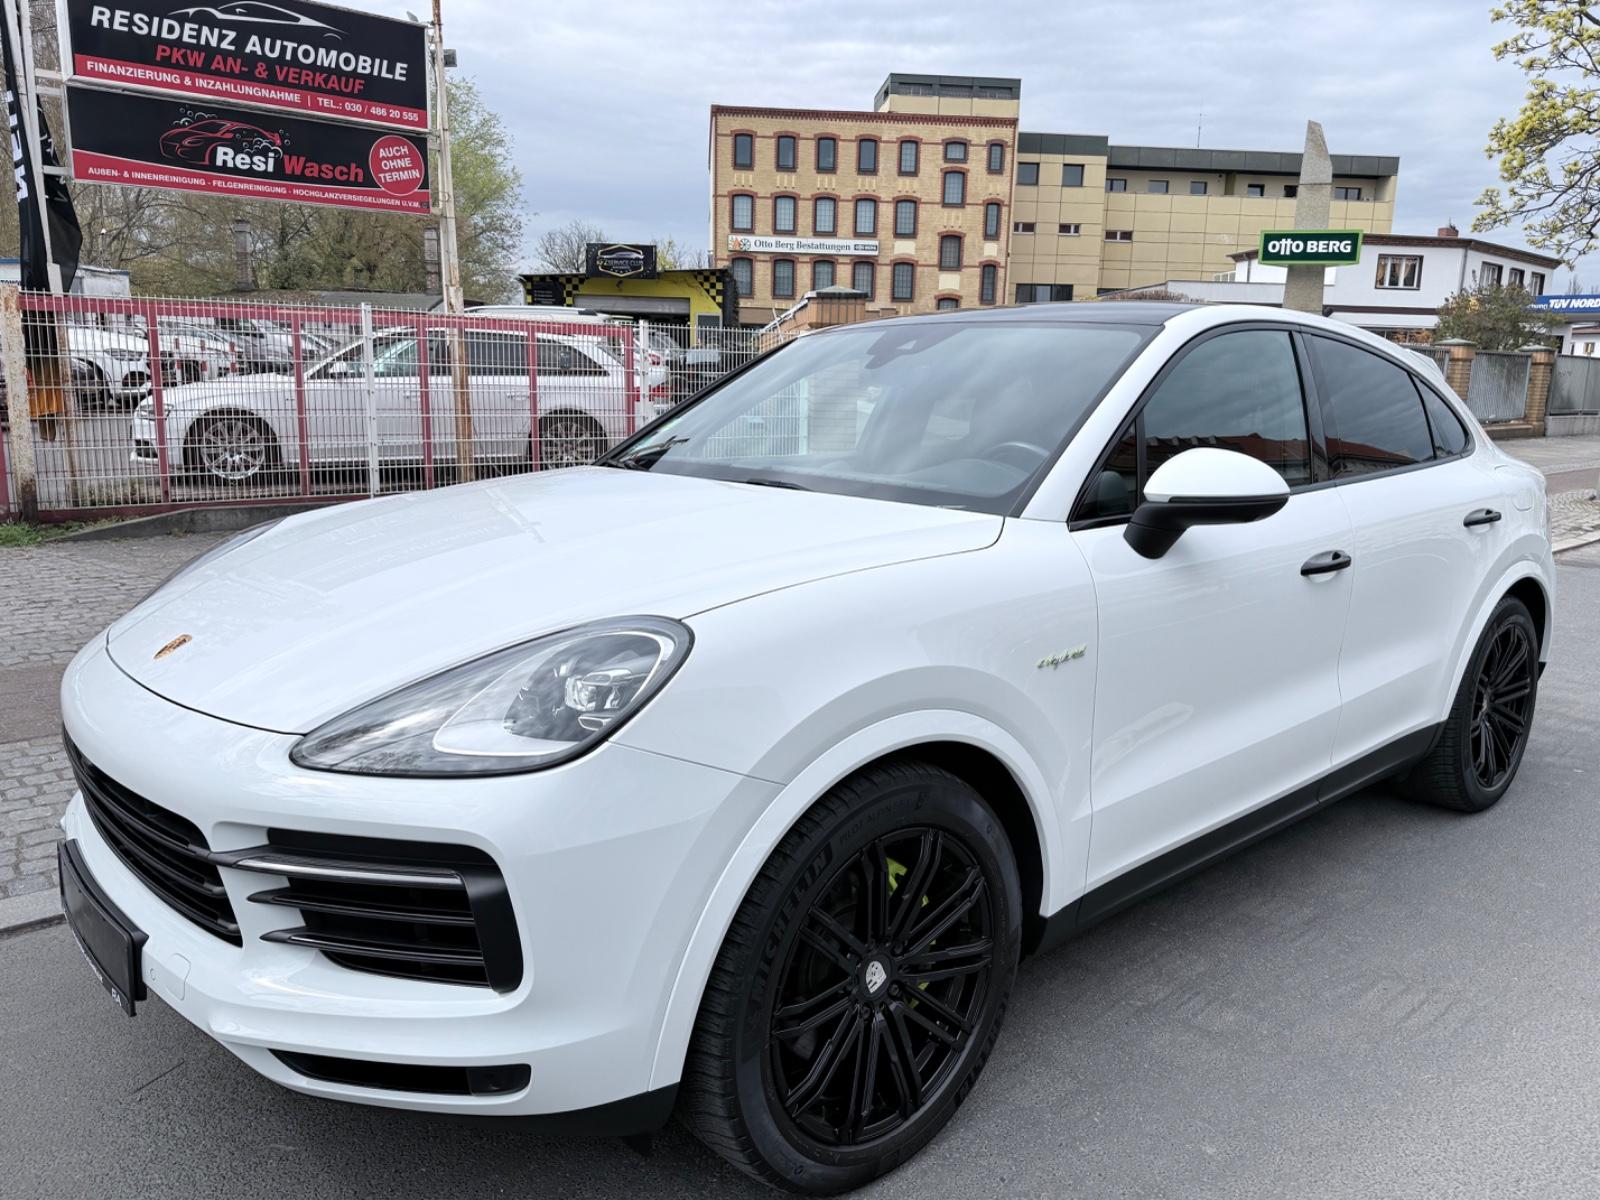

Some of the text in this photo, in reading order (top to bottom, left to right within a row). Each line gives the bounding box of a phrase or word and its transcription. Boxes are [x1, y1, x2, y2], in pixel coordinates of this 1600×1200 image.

[90, 5, 409, 81] RESIDENZ AUTOMOBILE
[155, 44, 365, 94] PKW AN- & VERKAUF
[87, 61, 302, 103] FINANZIERUNG & INZAHLUNGNAHME
[317, 97, 343, 110] TEL.:
[344, 102, 362, 113] 030
[370, 106, 387, 117] 486
[389, 108, 401, 119] 20
[402, 110, 419, 122] 555
[379, 145, 409, 158] AUCH
[215, 146, 364, 183] Resi Wasch
[381, 157, 413, 170] OHNE
[123, 170, 130, 178] &
[132, 171, 206, 186] INNENREINIGUNG
[212, 179, 287, 194] FELGENREINIGUNG
[378, 169, 421, 184] TERMIN
[753, 239, 773, 248] Otto
[774, 240, 794, 251] Berg
[796, 240, 851, 252] Bestattungen
[1306, 240, 1352, 253] BERG
[1569, 298, 1600, 309] NORD
